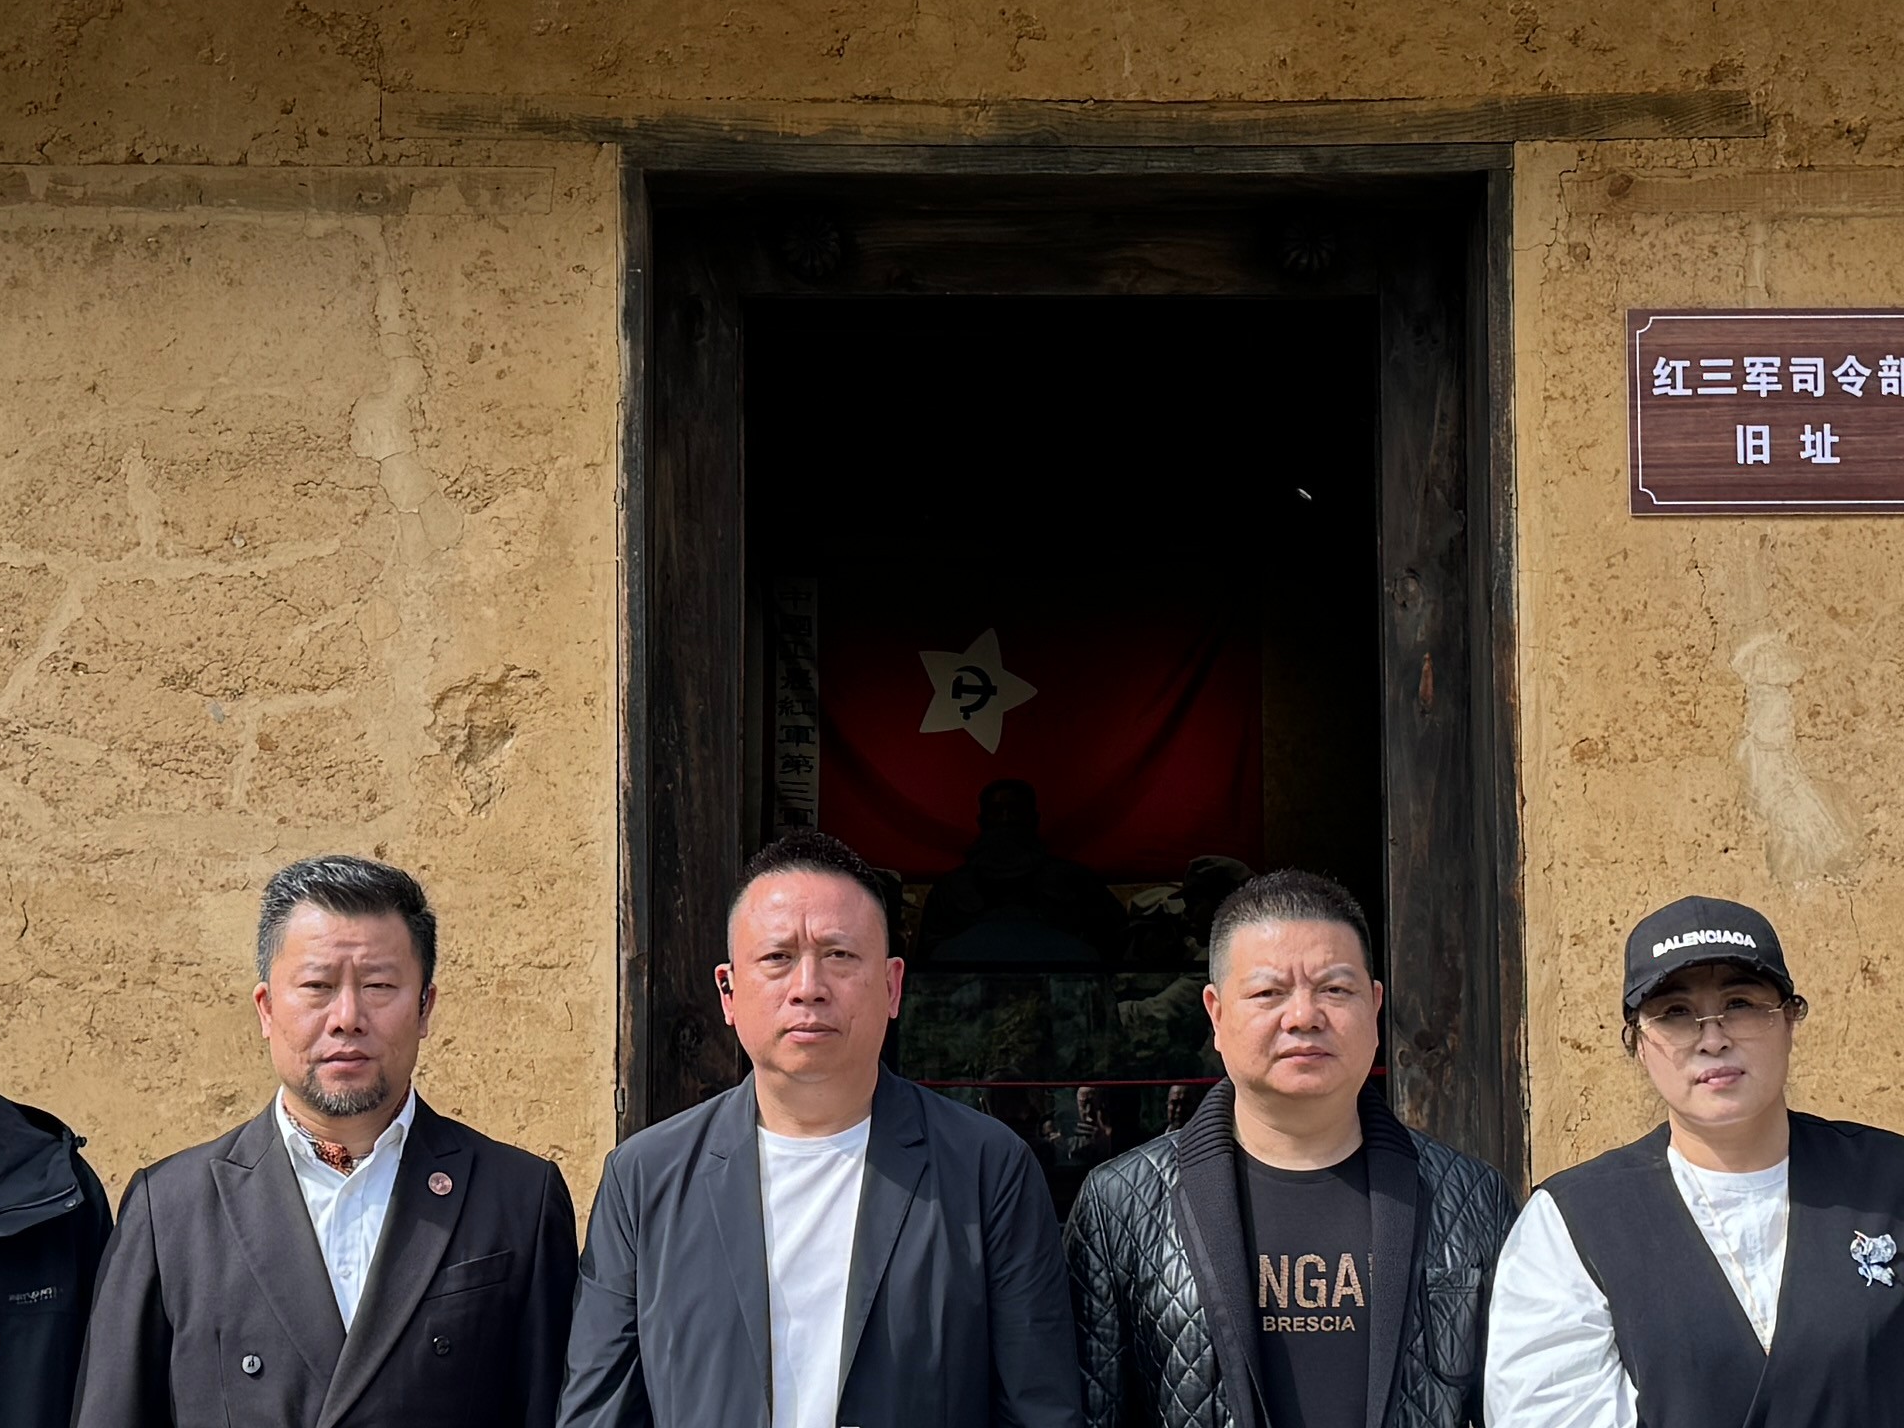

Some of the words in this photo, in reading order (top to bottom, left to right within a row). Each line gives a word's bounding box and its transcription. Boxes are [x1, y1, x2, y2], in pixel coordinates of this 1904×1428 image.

[1736, 423, 1841, 465] 旧址
[1258, 1252, 1373, 1309] NGA
[1262, 1315, 1356, 1332] BRESCIA
